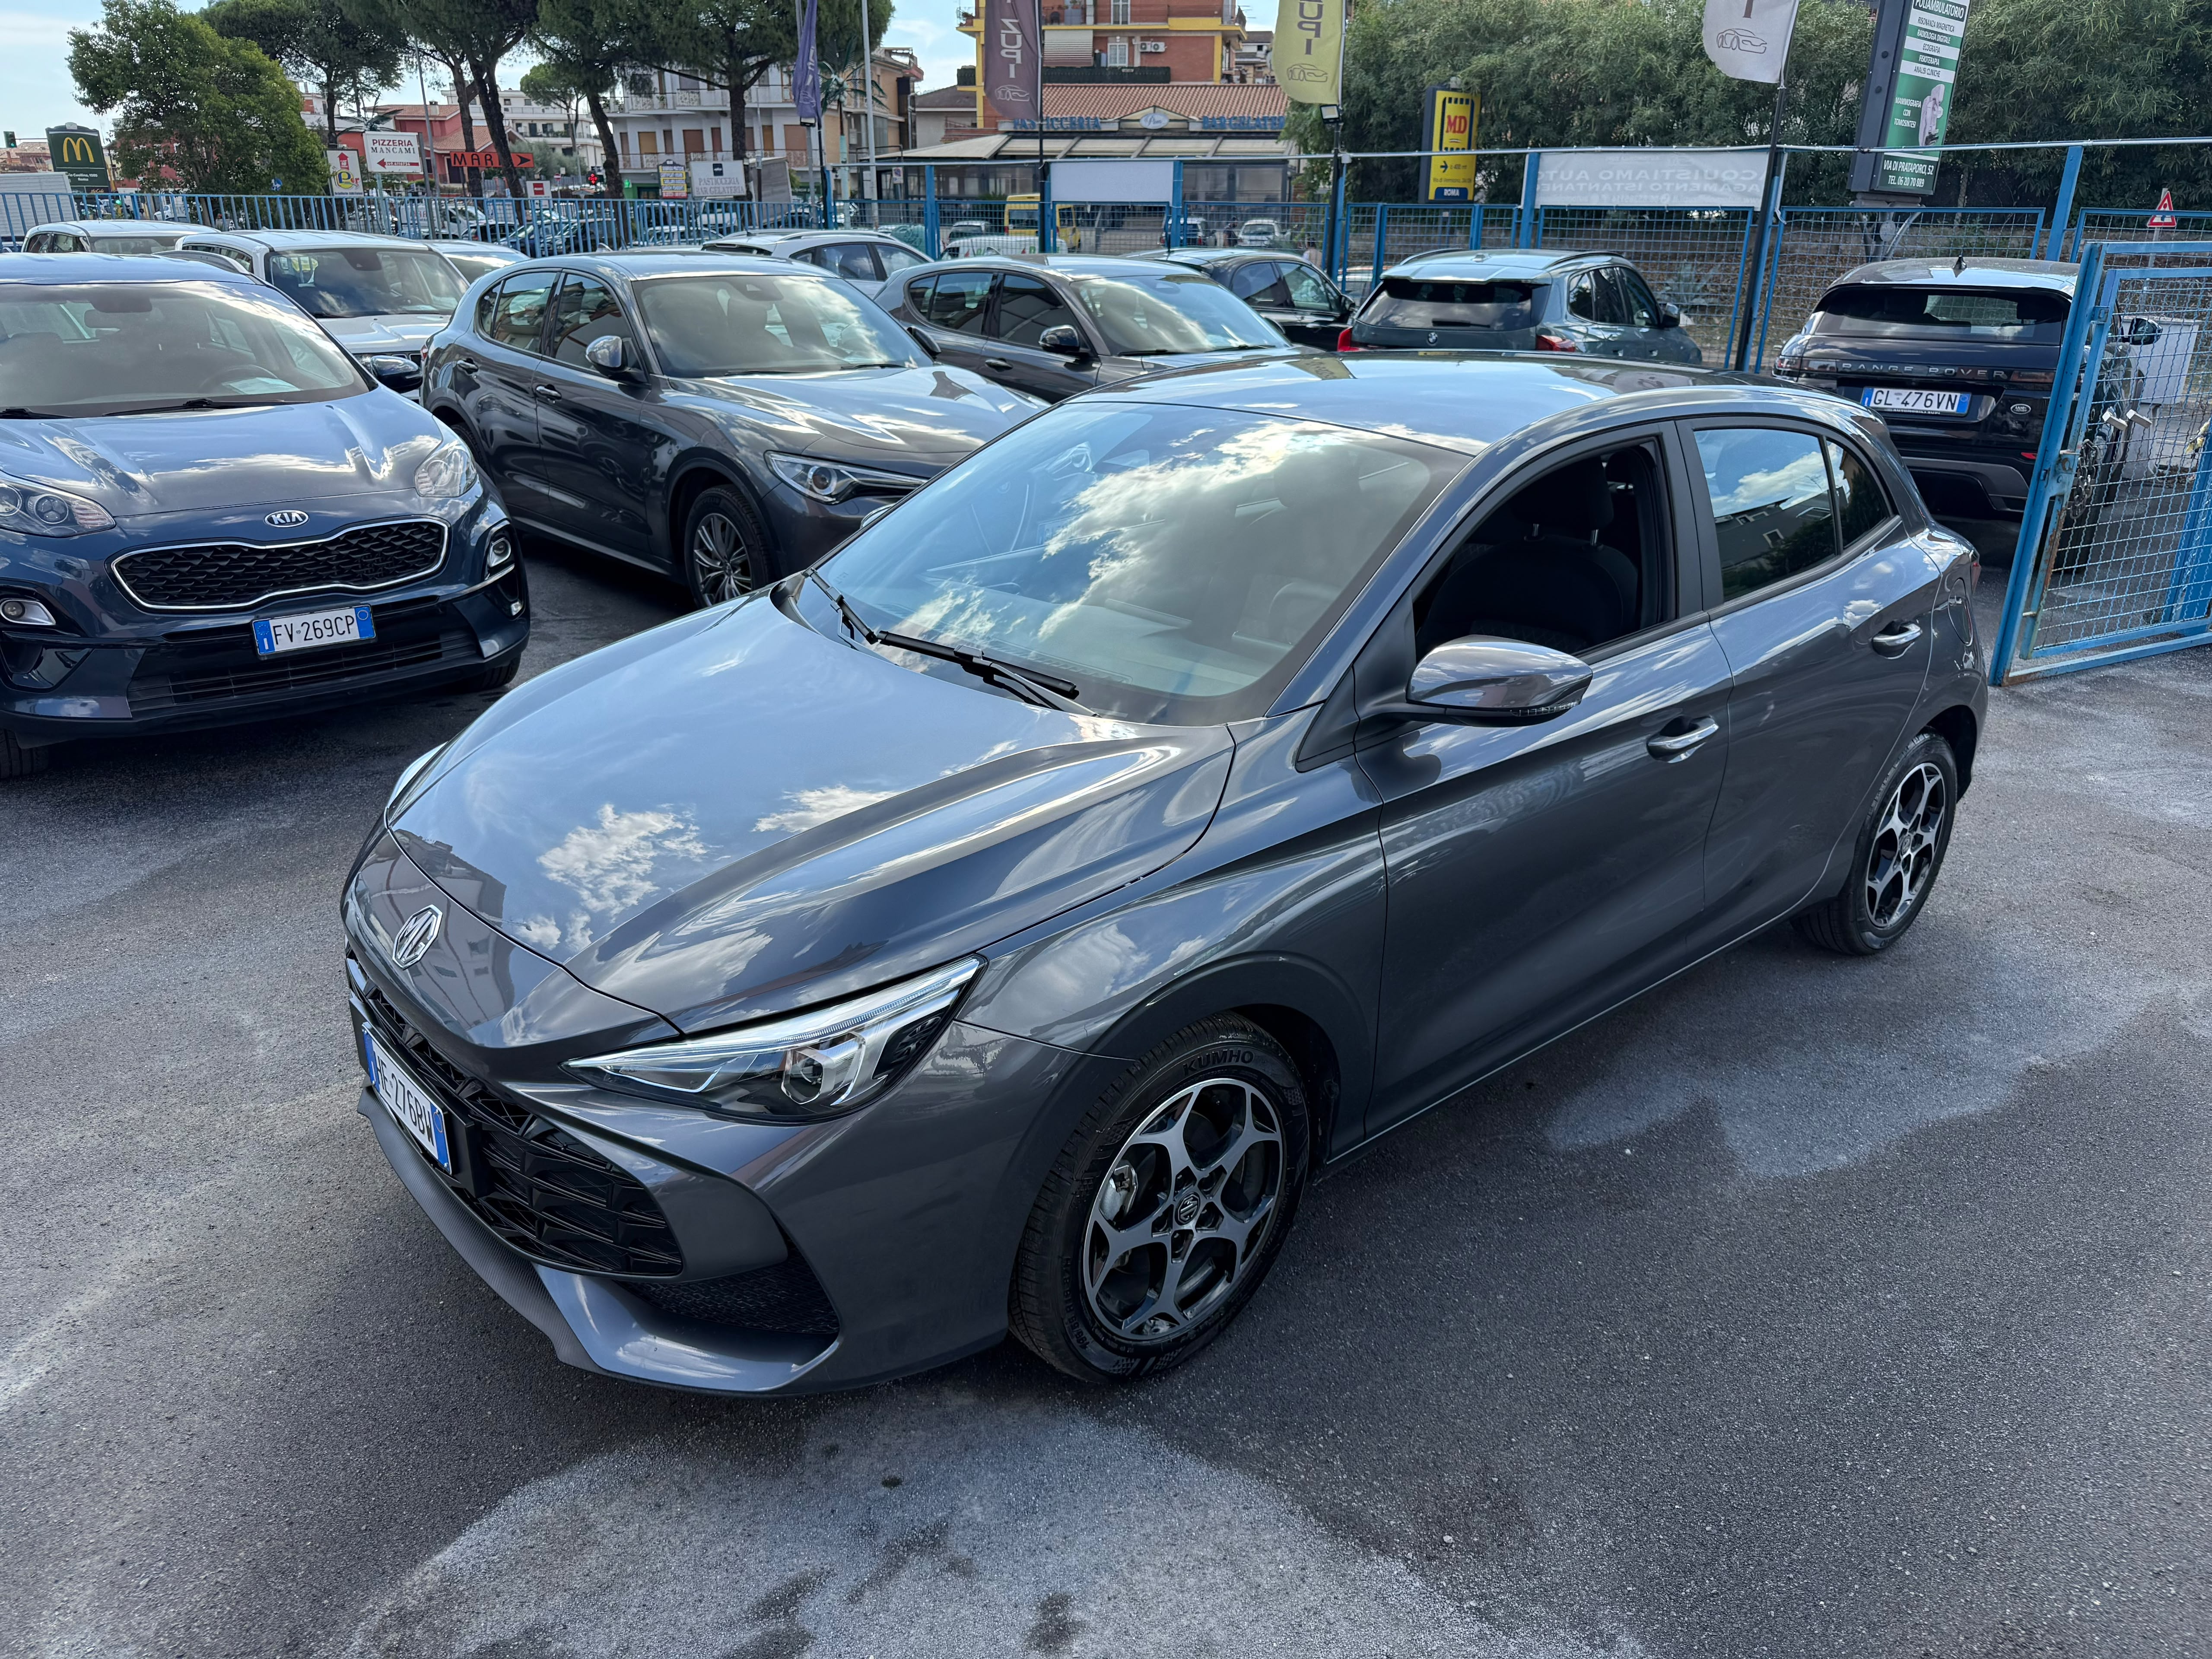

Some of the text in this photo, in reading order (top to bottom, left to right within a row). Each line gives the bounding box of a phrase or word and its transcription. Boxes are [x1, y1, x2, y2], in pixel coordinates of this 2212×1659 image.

[1918, 17, 1955, 32] RISONANZA MAGNETICA
[1917, 29, 1936, 41] RADIOLOGIA
[1923, 43, 1940, 54] ECOGRAFIA
[1919, 55, 1939, 66] FISIOTERAPIA
[1914, 66, 1941, 77] ANALISI CLINICHE
[1895, 97, 1922, 108] MAMMOGRAFIA
[1013, 116, 1101, 130] PASICCERIA
[1446, 115, 1468, 133] MD
[1894, 118, 1916, 128] TOMOSINTESI
[1884, 160, 1934, 175] VIA DI PRATAPORCI, 52
[1888, 175, 1924, 187] TEL. 06 20 70 889
[1842, 363, 2008, 379] RANGE ROVER
[271, 512, 303, 525] KIA
[397, 911, 437, 963] MG
[1183, 1049, 1254, 1076] KUMHO
